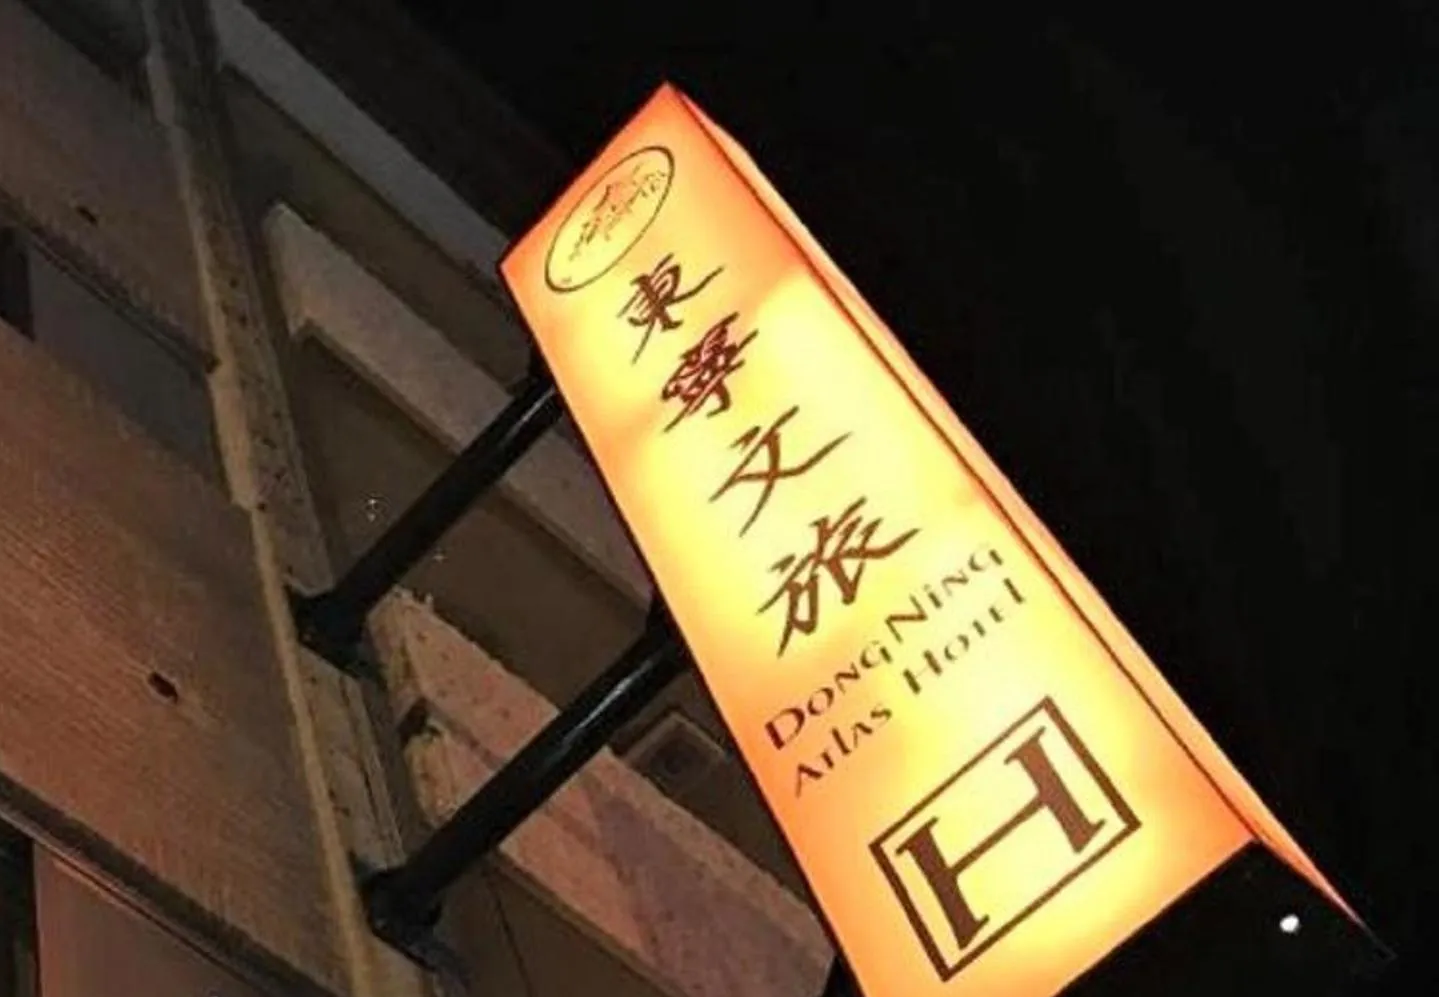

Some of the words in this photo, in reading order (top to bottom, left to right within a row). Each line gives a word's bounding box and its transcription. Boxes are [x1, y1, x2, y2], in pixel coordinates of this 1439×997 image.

[616, 252, 923, 659] 東寧文旅
[895, 726, 1106, 951] H
